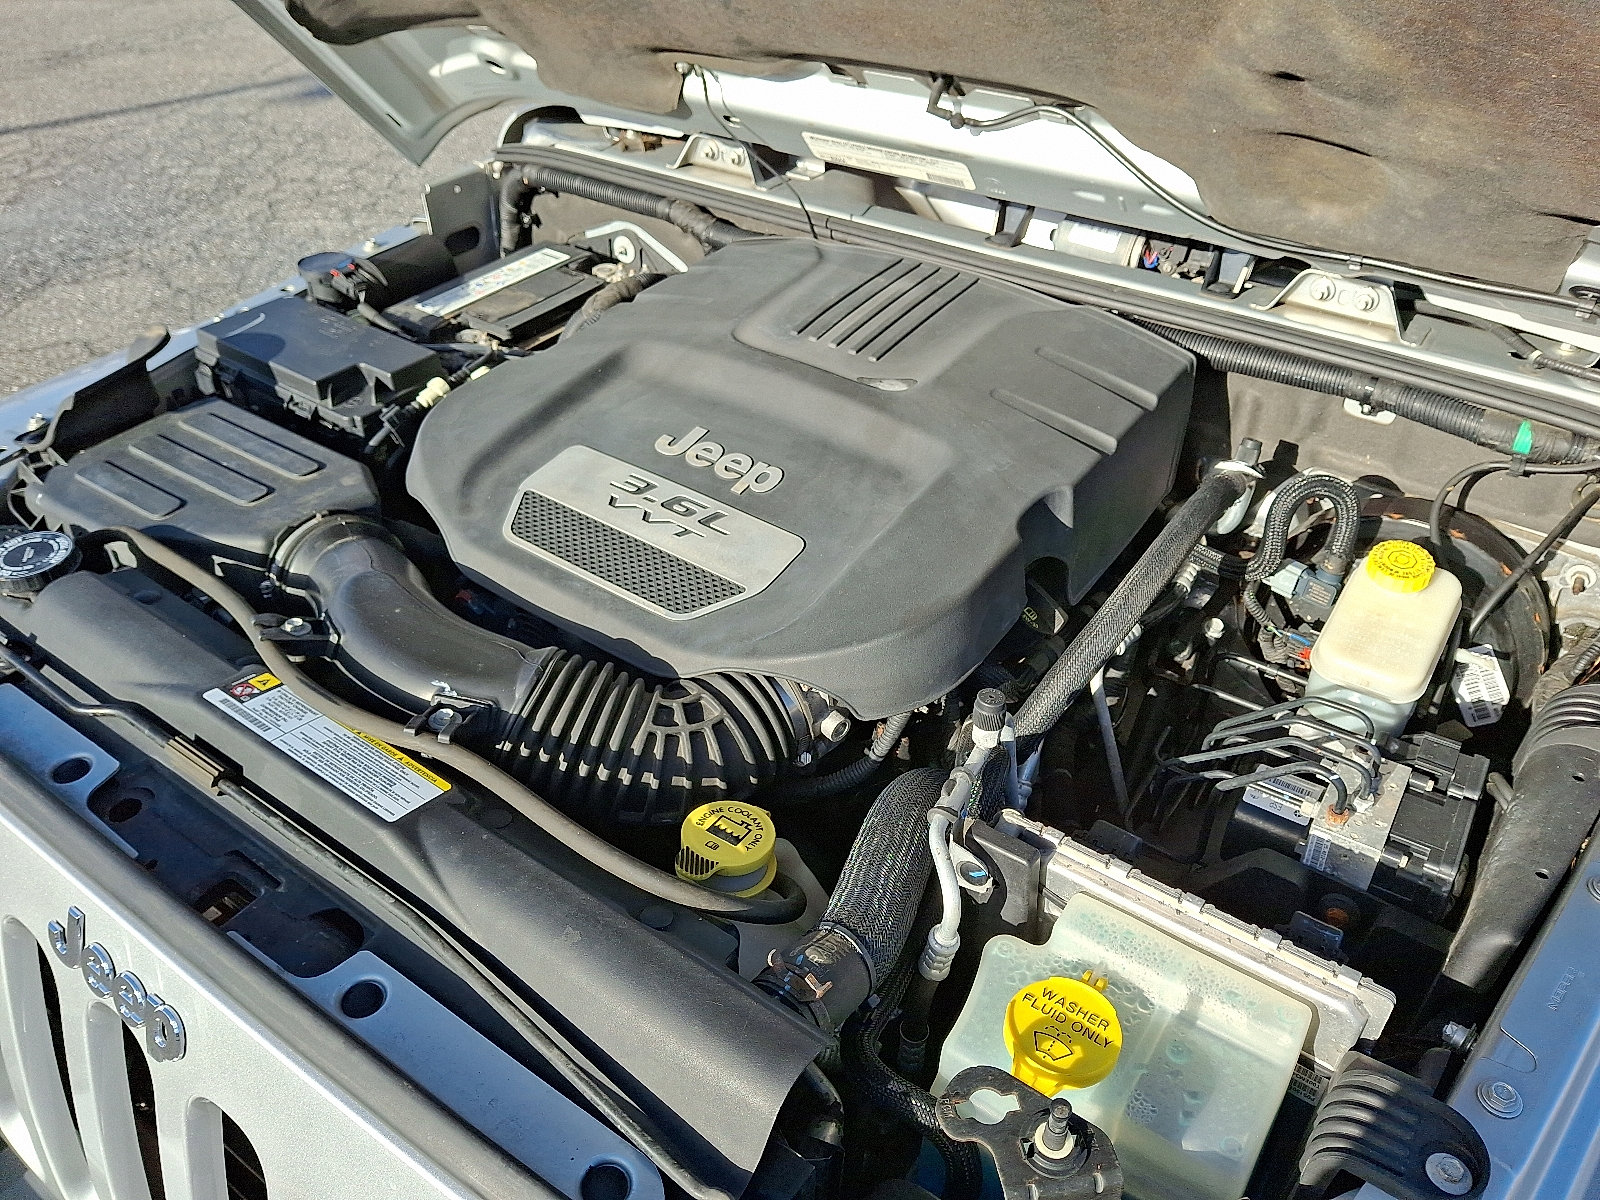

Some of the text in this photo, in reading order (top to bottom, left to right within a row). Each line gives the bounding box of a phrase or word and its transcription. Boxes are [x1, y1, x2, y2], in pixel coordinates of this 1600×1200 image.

[655, 426, 785, 495] Jeep
[608, 493, 706, 538] VVT
[609, 473, 731, 536] 3.6L
[695, 806, 764, 852] ENGINE COOLANT ONLY
[47, 905, 187, 1063] Jeep
[1041, 986, 1111, 1032] WASHER
[1022, 992, 1113, 1049] FLUID ONLY
